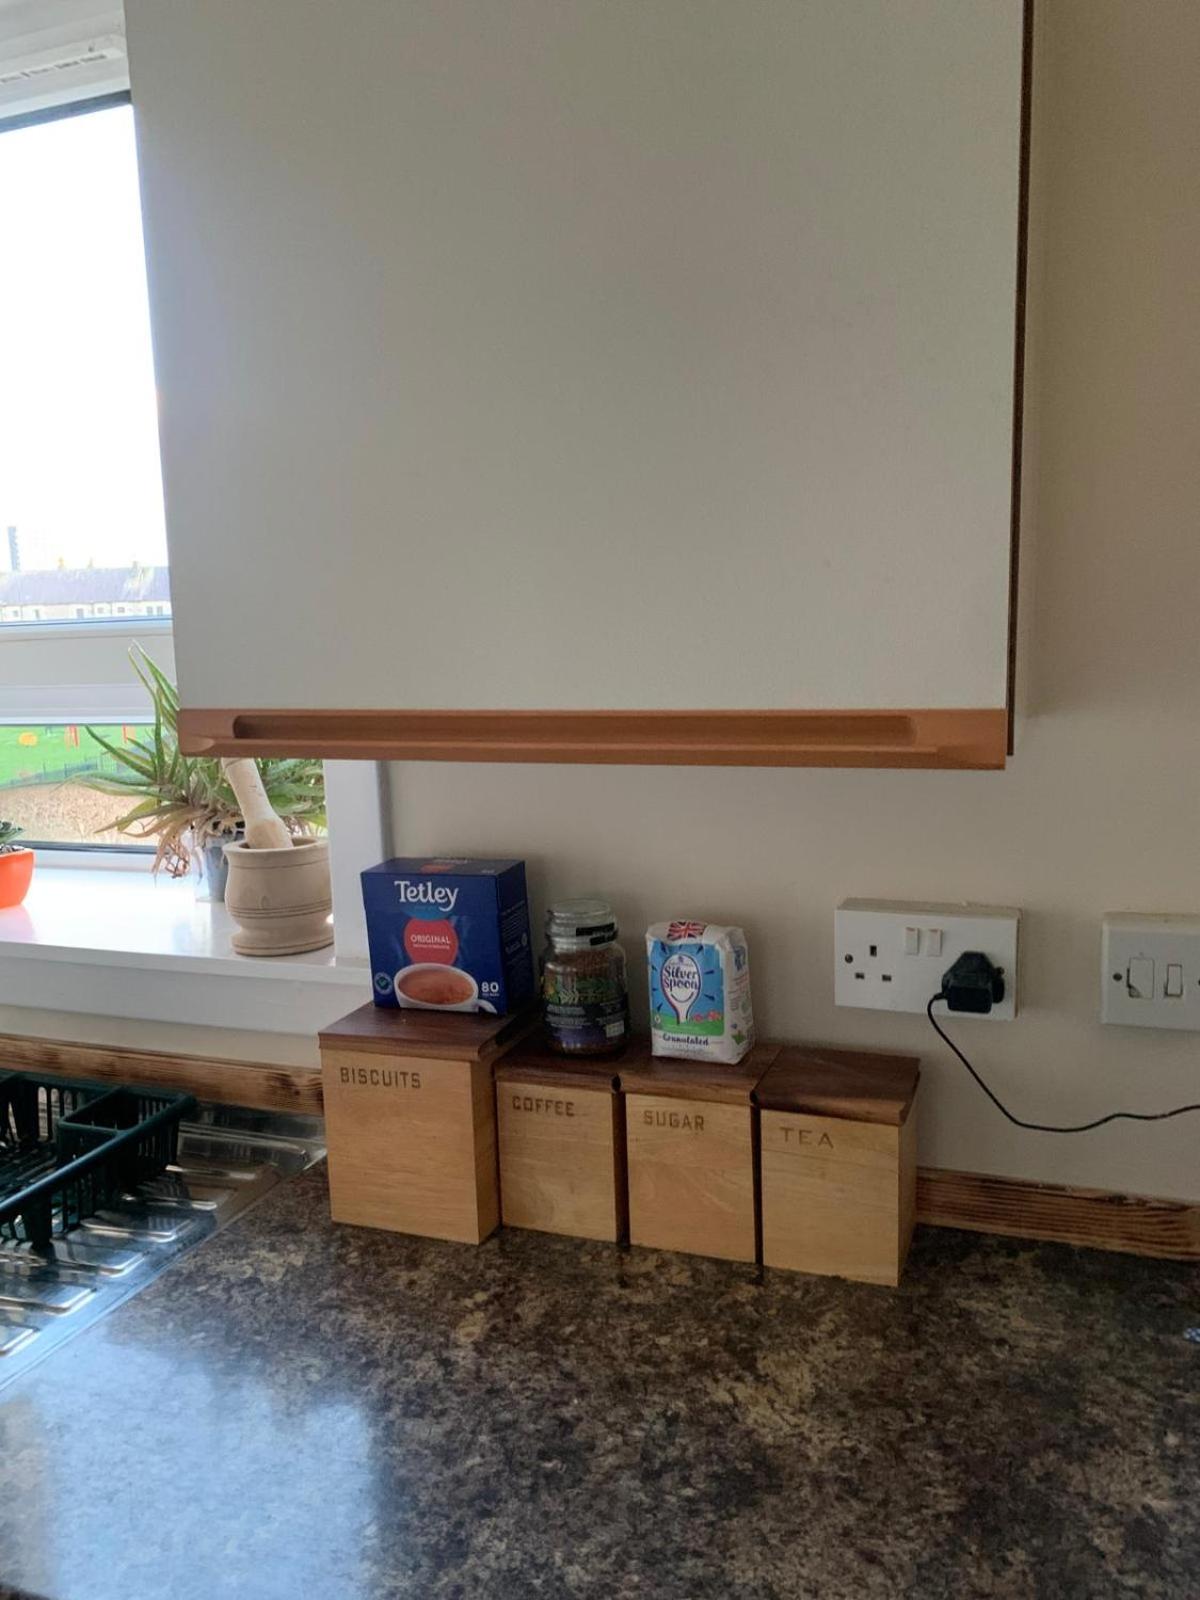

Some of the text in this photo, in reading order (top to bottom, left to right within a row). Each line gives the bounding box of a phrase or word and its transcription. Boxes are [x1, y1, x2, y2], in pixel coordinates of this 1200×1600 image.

[394, 880, 459, 912] Tetley
[410, 934, 451, 945] ORIGINAL
[664, 965, 698, 981] Silver
[481, 981, 499, 993] 80
[664, 977, 699, 992] Spoon
[340, 1066, 421, 1089] BISCUITS
[512, 1095, 575, 1117] COFFEE
[643, 1110, 705, 1131] SUGAR
[779, 1126, 834, 1149] TEA
